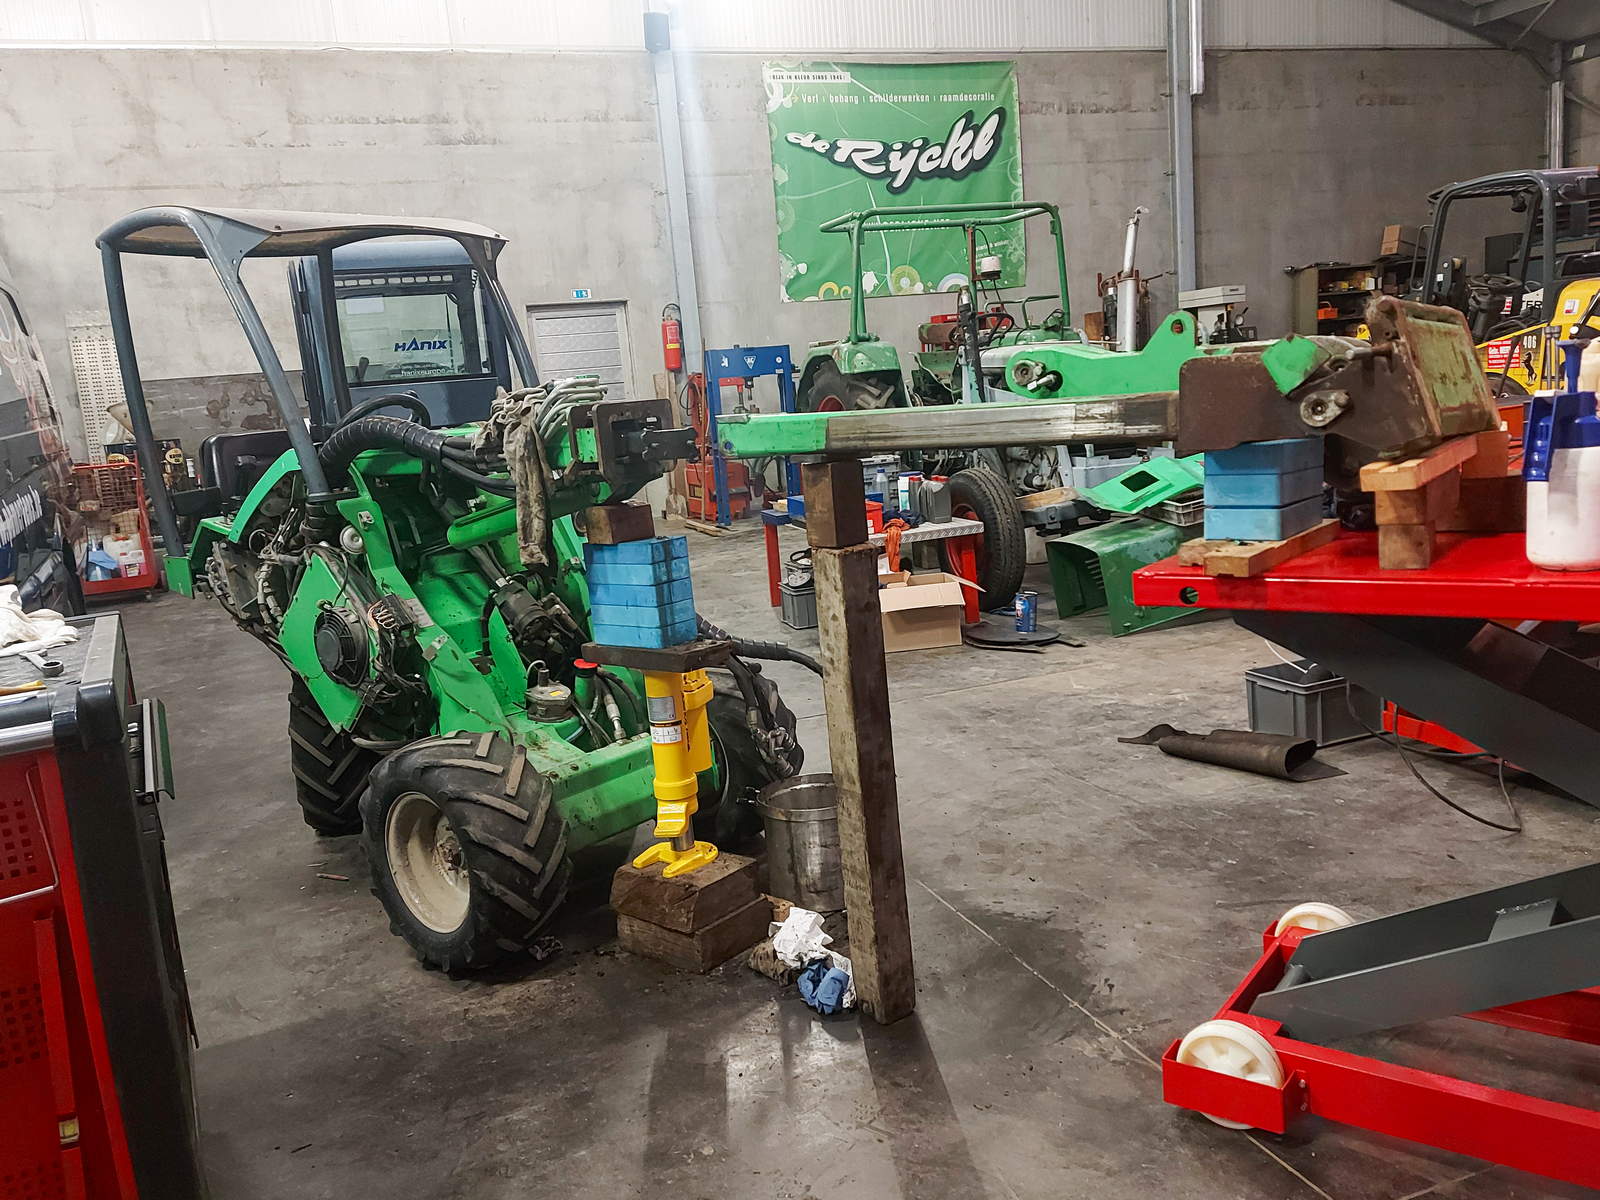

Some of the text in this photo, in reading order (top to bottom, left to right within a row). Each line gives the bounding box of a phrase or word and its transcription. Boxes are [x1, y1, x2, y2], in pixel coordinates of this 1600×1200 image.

[829, 92, 859, 105] behang
[869, 92, 930, 103] schilderwerken
[940, 91, 995, 102] raamdecoratie
[786, 132, 830, 153] de
[394, 337, 448, 352] HANIX
[1523, 335, 1537, 349] 406
